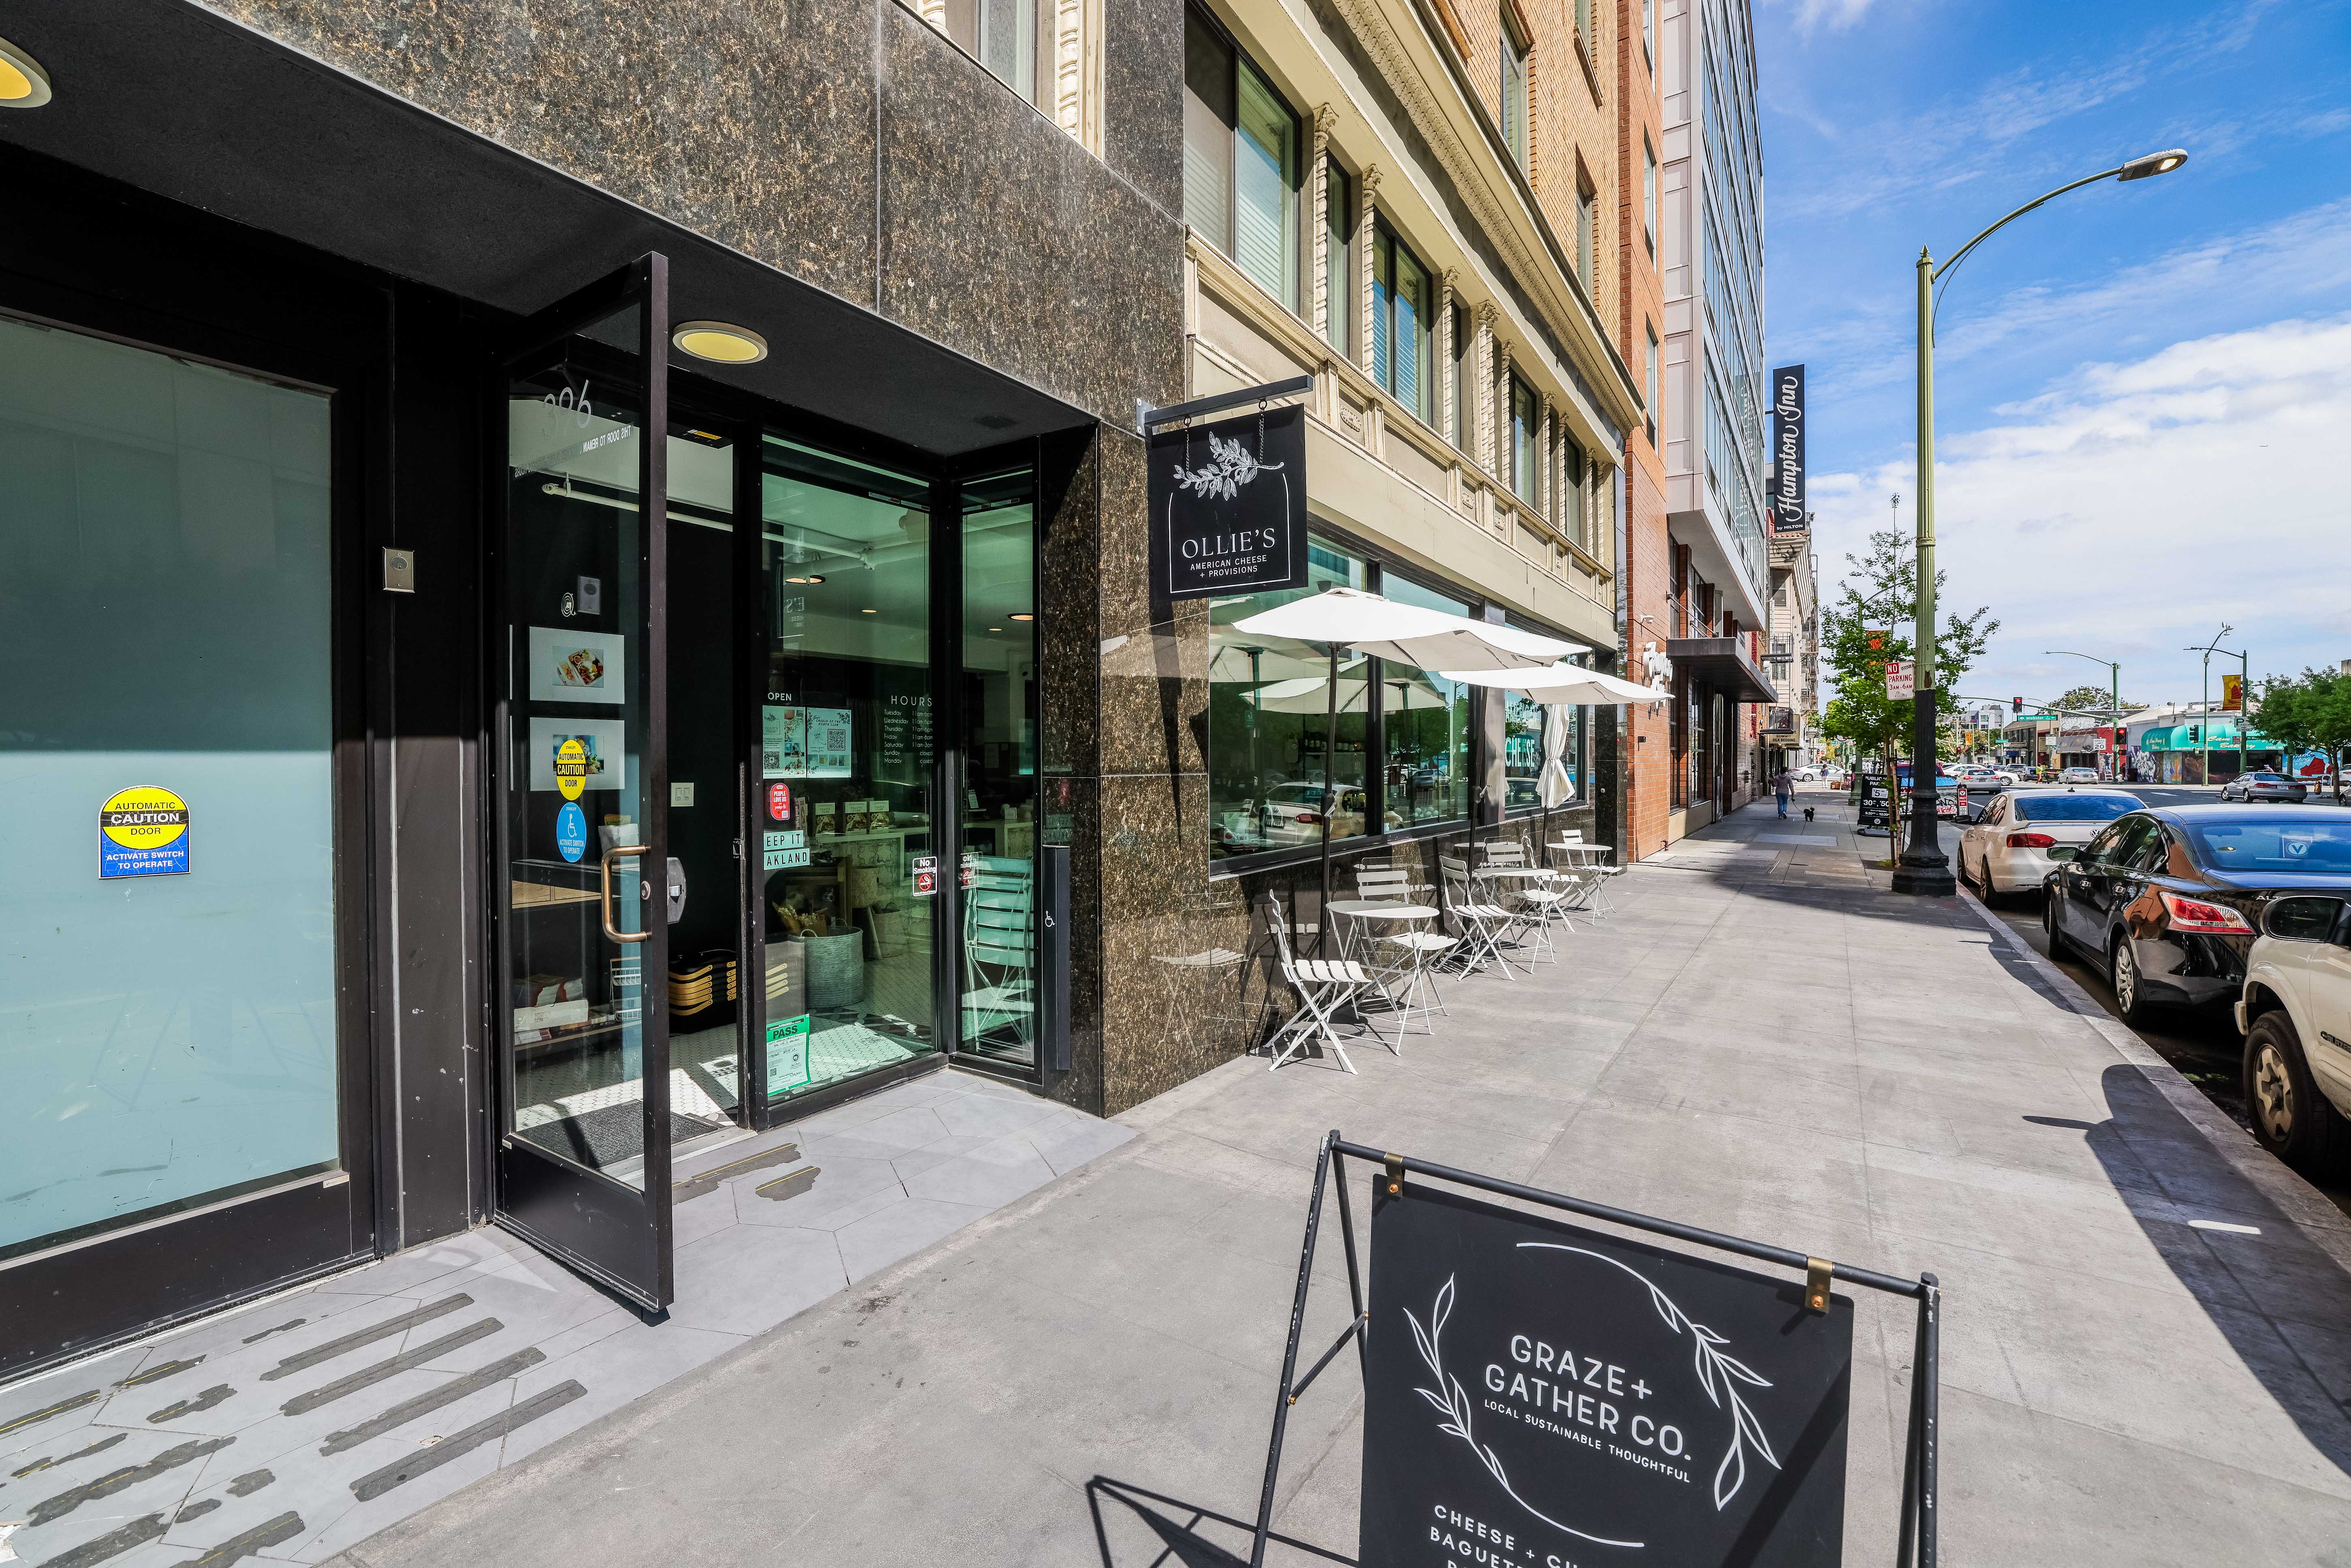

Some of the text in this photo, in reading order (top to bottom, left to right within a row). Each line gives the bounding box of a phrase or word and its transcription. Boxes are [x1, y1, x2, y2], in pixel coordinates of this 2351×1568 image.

[1777, 376, 1801, 421] Inn
[1777, 425, 1803, 522] Hampton
[1182, 528, 1275, 558] OLLIE'S
[1190, 554, 1267, 571] AMERICAN CHEESE
[1209, 565, 1258, 578] PROVISIONS
[1888, 664, 1897, 673] NO
[1889, 674, 1912, 682] PARKING
[768, 692, 792, 701] OPEN
[891, 695, 932, 707] HOURS
[1505, 737, 1535, 767] CHEESE
[557, 764, 585, 775] CAUTION
[111, 813, 180, 824] CAUTION
[767, 834, 800, 847] EEP IT
[106, 852, 149, 861] ACTIVATE
[767, 852, 807, 866] AKLAND
[920, 859, 930, 867] No
[133, 860, 173, 868] OPERATE
[773, 1025, 798, 1039] PASS
[1485, 1364, 1691, 1461] GATHER CO.
[1485, 1399, 1690, 1483] LOCAL SUSTAINABLE THOUGHTFUL
[1434, 1504, 1515, 1551] CHEESE
[1526, 1549, 1535, 1559] +
[1430, 1526, 1524, 1568] BAGUET
